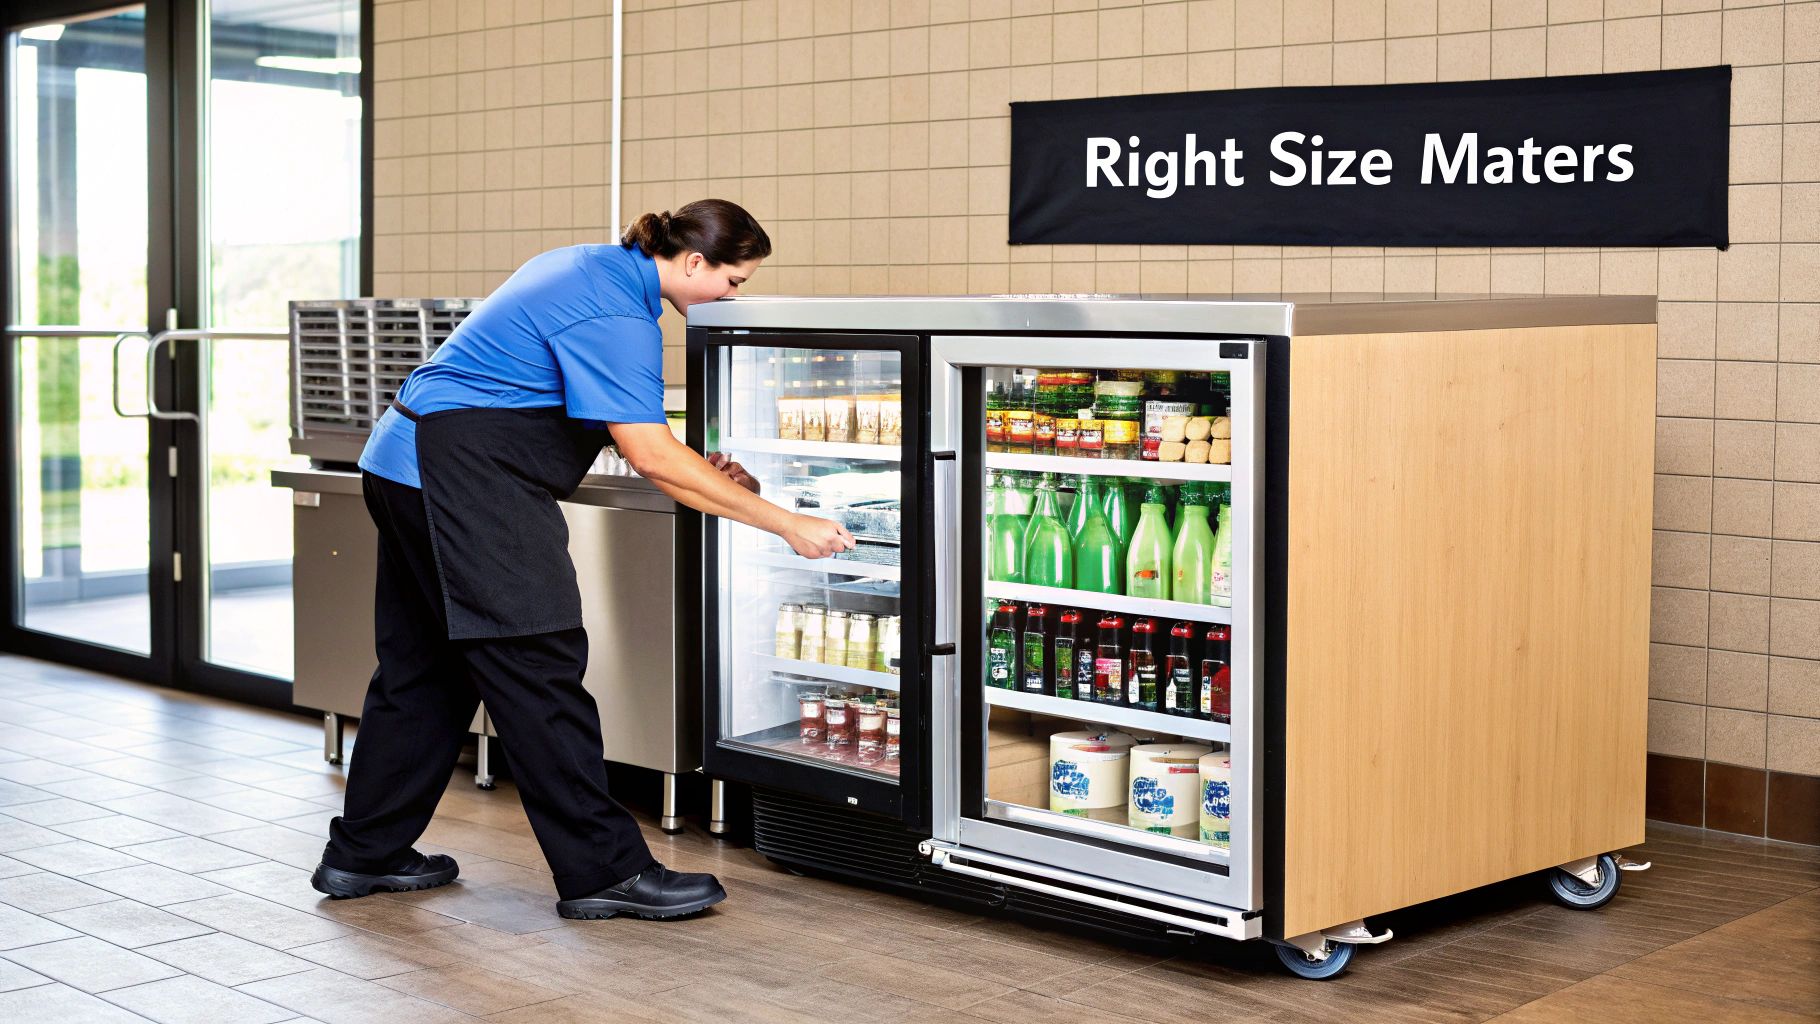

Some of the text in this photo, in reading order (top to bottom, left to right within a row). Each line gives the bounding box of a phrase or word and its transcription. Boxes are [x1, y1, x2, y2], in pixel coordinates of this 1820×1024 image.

[1086, 131, 1635, 199] Right Size Maters
